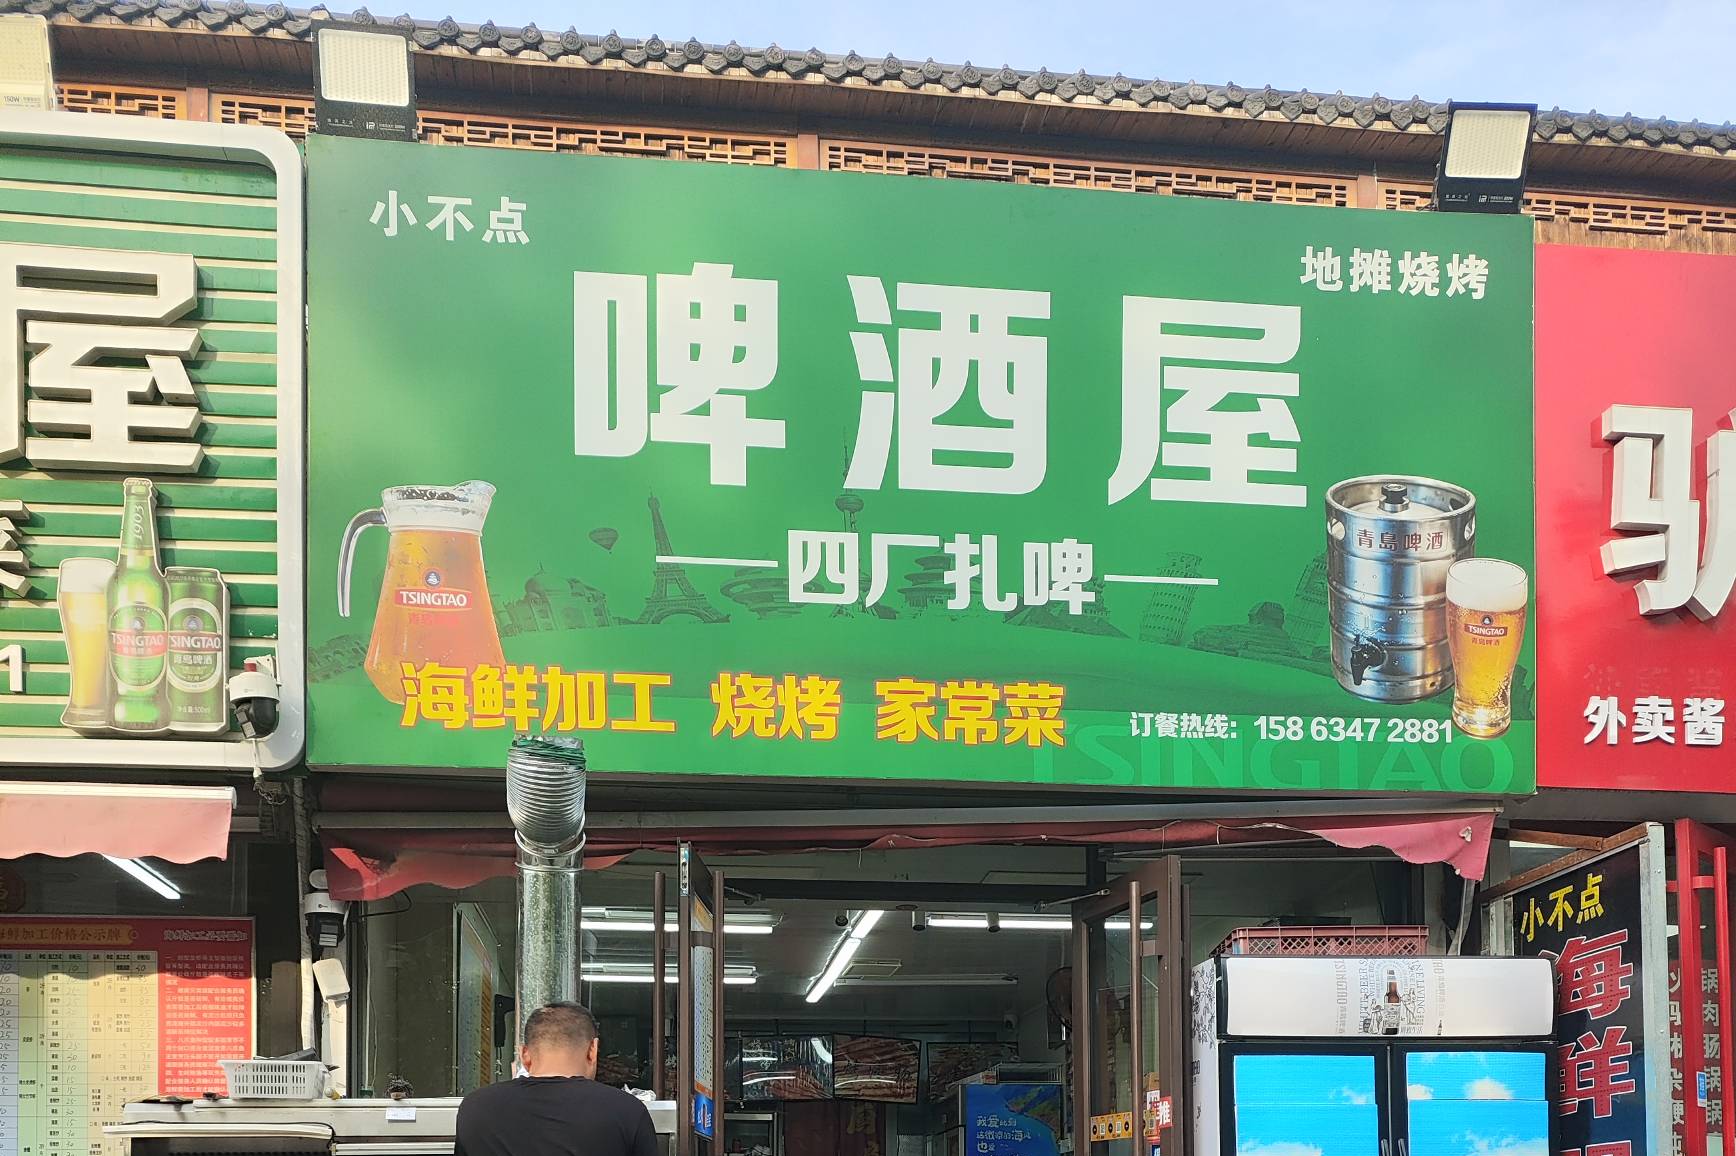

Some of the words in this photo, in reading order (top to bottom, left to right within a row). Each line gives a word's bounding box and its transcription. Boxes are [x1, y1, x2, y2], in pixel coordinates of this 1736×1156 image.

[369, 189, 531, 246] 小不点
[1299, 245, 1490, 300] 地摊烧烤
[0, 242, 203, 474] 屋
[573, 261, 1308, 508] 啤酒屋
[399, 591, 468, 607] TSINGTAO
[788, 528, 1096, 616] 四厂扎啤
[112, 631, 165, 651] TSINGTAO
[1467, 625, 1505, 636] TSINGTAO
[400, 661, 676, 735] 海鲜加工
[709, 671, 843, 742] 烧烤
[874, 677, 1066, 748] 家常菜
[1253, 714, 1308, 741] 158
[1310, 715, 1384, 742] 6347
[1386, 716, 1454, 744] 2881
[1583, 694, 1725, 747] 外卖酱
[1519, 872, 1604, 943] 小不点
